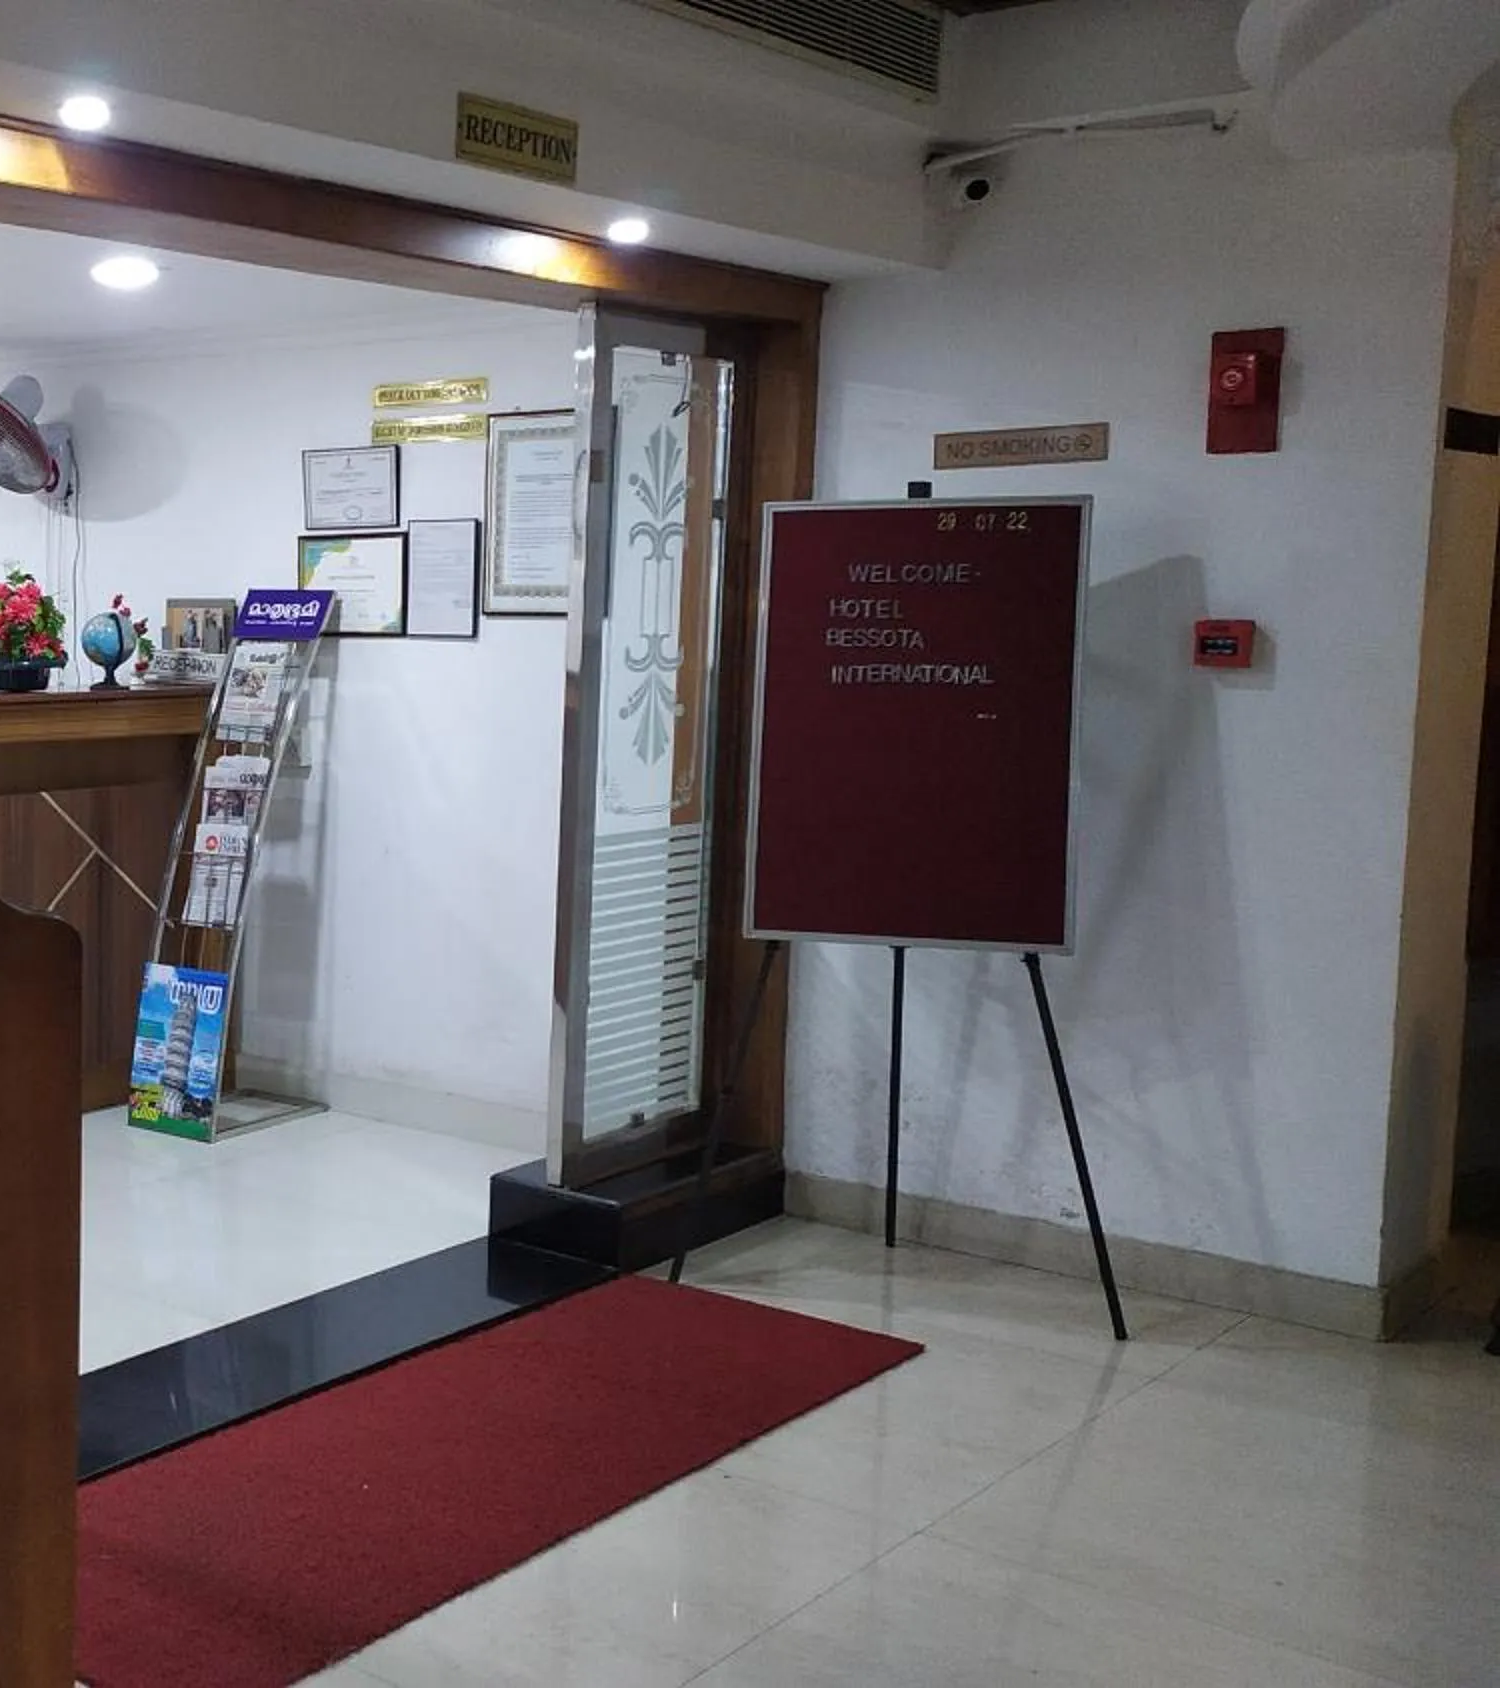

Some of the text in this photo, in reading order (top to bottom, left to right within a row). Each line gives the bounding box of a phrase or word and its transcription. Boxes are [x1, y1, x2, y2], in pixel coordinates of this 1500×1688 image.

[465, 114, 572, 164] RECEPTION
[946, 433, 1072, 460] NO SMOKING
[829, 600, 904, 619] HOTEL
[826, 628, 925, 650] BESSOTA
[831, 664, 996, 686] INTERNATIONAL
